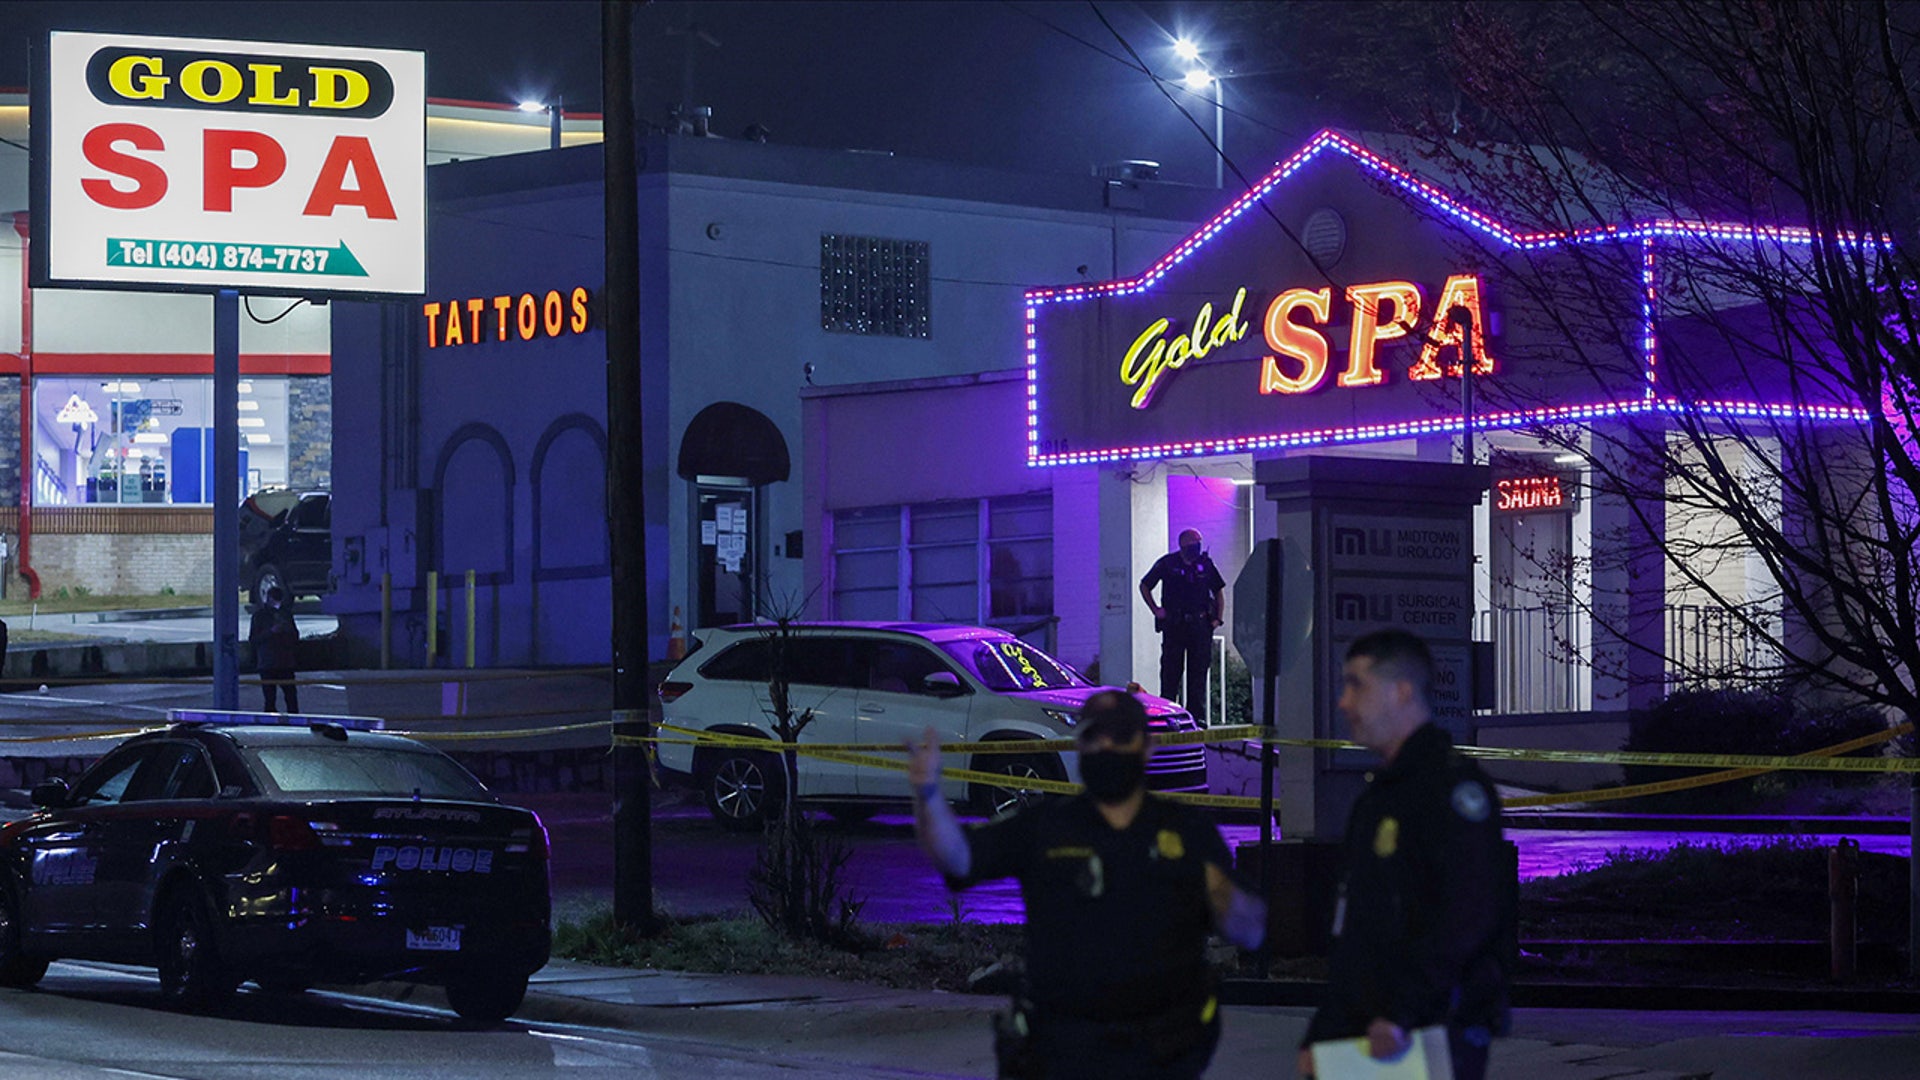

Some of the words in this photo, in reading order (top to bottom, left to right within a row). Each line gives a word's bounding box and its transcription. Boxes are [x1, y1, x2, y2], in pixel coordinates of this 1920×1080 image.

[108, 54, 371, 110] GOLD
[80, 122, 398, 221] SPA
[119, 241, 153, 265] Tel
[158, 243, 217, 269] (404)
[223, 245, 329, 272] 874-7737
[423, 286, 588, 349] TATTOOS
[1120, 286, 1249, 409] Gold
[1259, 273, 1496, 395] SPA
[1497, 477, 1562, 510] SAUNA
[1397, 529, 1460, 545] MIDTOWN
[1397, 545, 1461, 560] UROLOGY
[1398, 594, 1464, 609] SURGICAL
[1403, 610, 1457, 625] CENTER
[1437, 671, 1455, 685] NO
[1432, 689, 1459, 702] THRU
[1430, 706, 1466, 718] RAFFIC
[370, 845, 494, 874] POLICE
